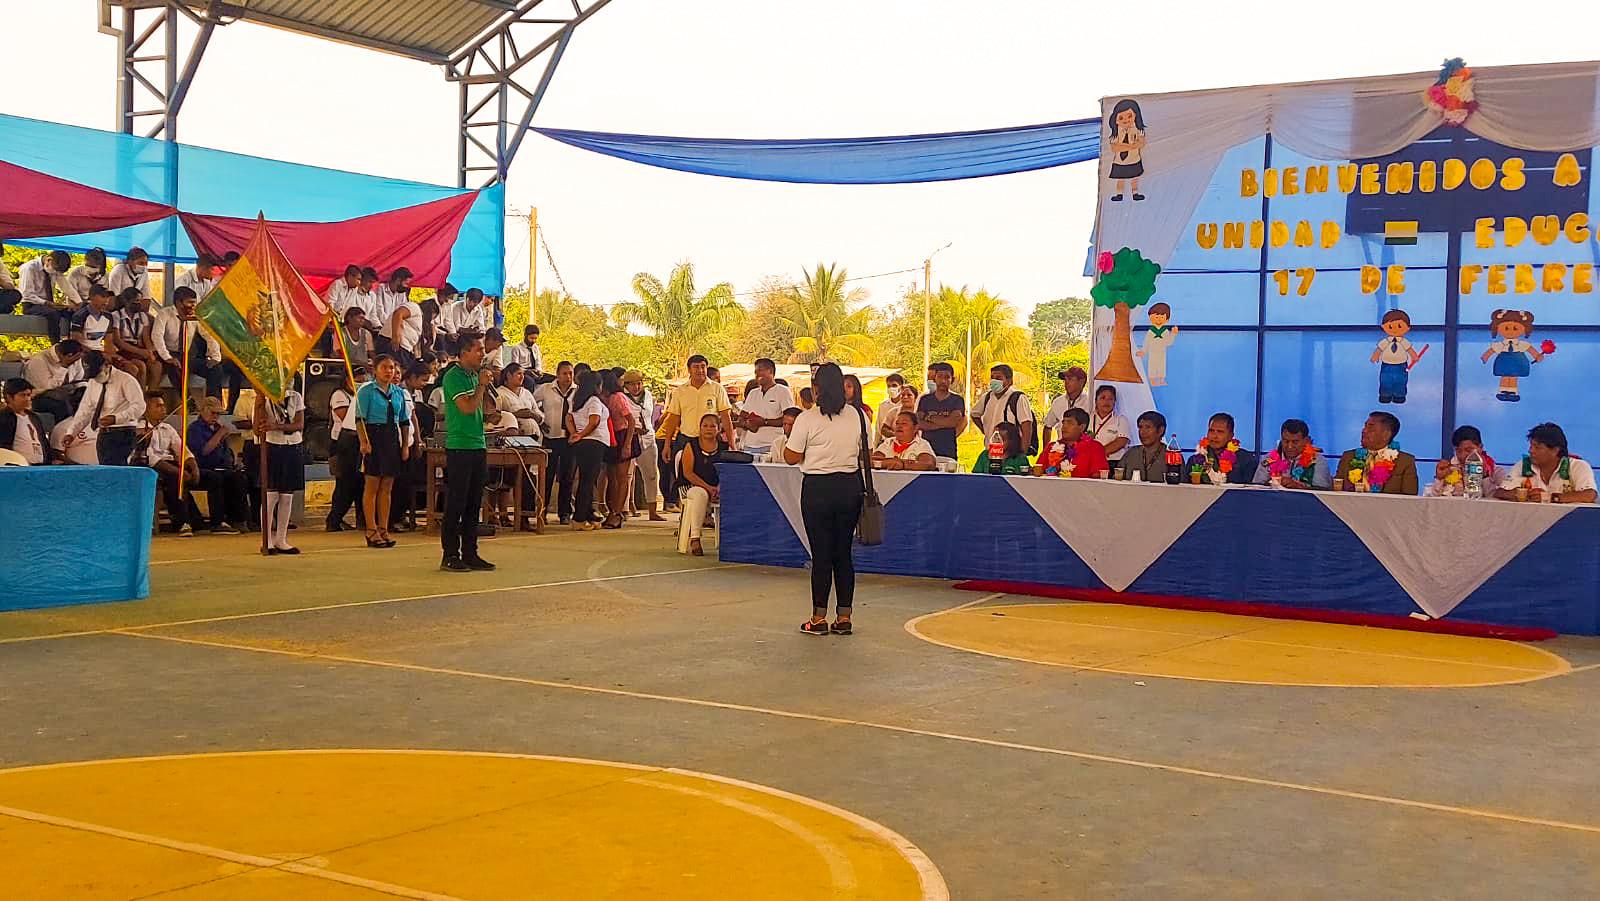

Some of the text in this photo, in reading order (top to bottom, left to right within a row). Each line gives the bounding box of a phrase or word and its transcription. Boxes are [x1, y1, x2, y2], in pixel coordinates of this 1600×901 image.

[1240, 153, 1581, 198] BIENVENIDOS A
[1196, 213, 1600, 249] UNIDAD EDUC
[1273, 262, 1593, 296] 17 DE FEBRE
